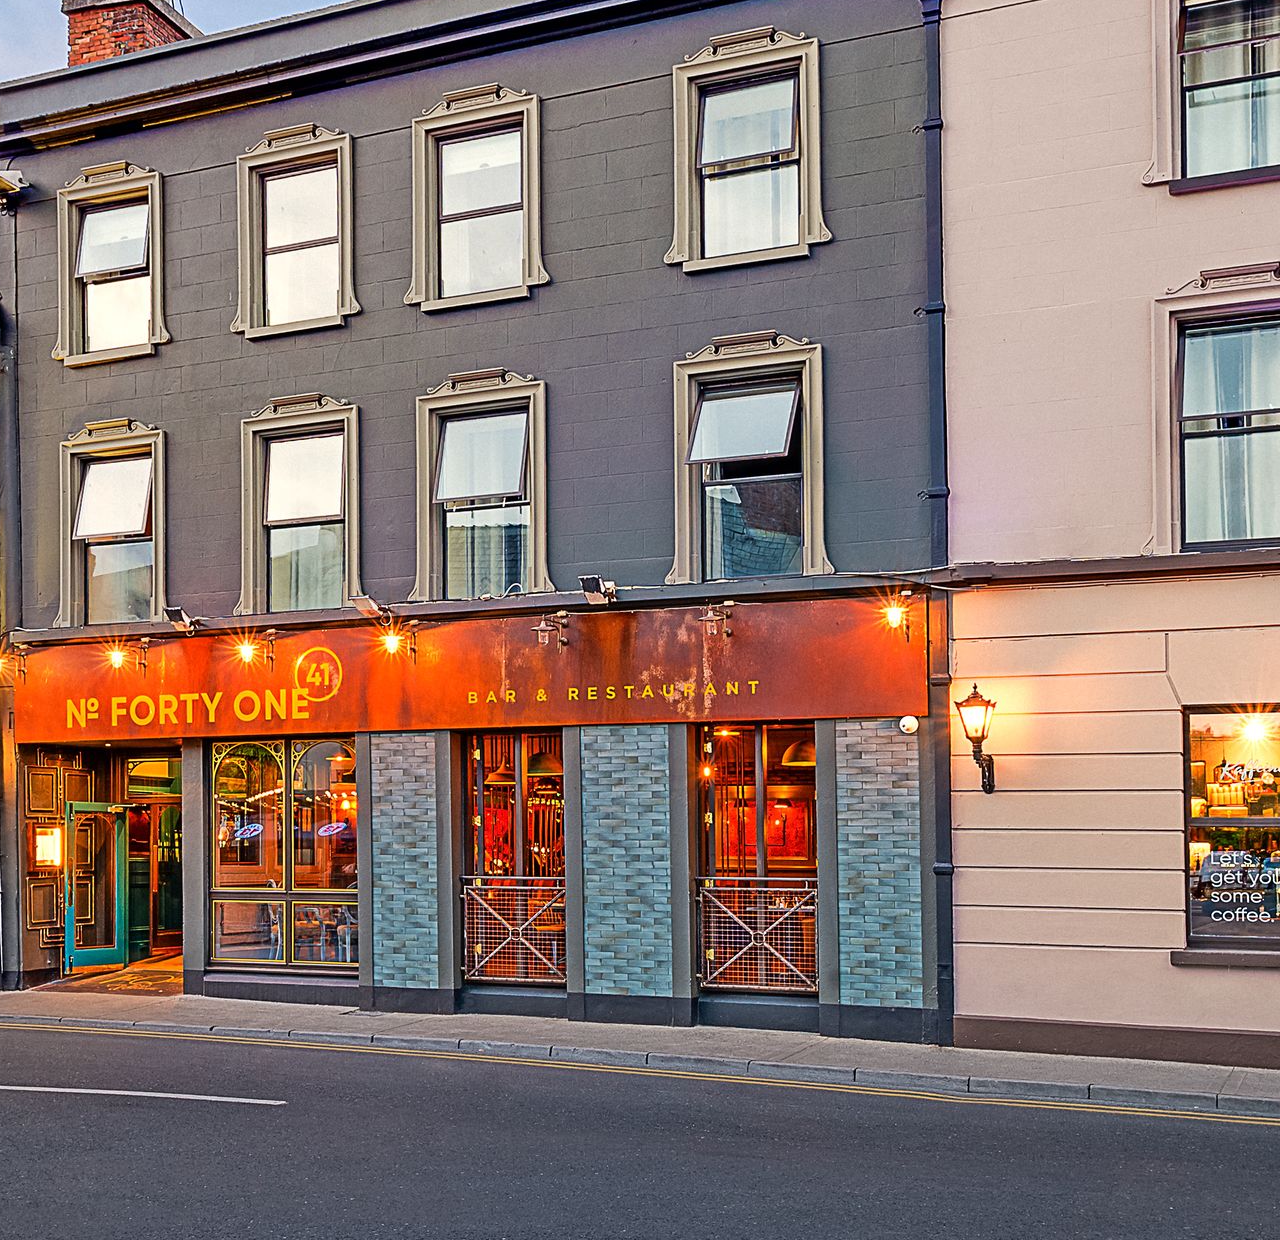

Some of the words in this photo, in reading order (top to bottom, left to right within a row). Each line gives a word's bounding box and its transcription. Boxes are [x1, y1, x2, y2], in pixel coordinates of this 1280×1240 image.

[305, 662, 330, 686] 41
[467, 690, 516, 704] BAR
[536, 689, 548, 702] &
[568, 680, 760, 701] RESTAURANT
[111, 691, 223, 727] FORTY
[233, 688, 309, 721] ONE
[1210, 851, 1253, 865] Let's
[1210, 871, 1247, 888] get
[1211, 892, 1263, 903] some
[1211, 907, 1275, 923] coffee.
